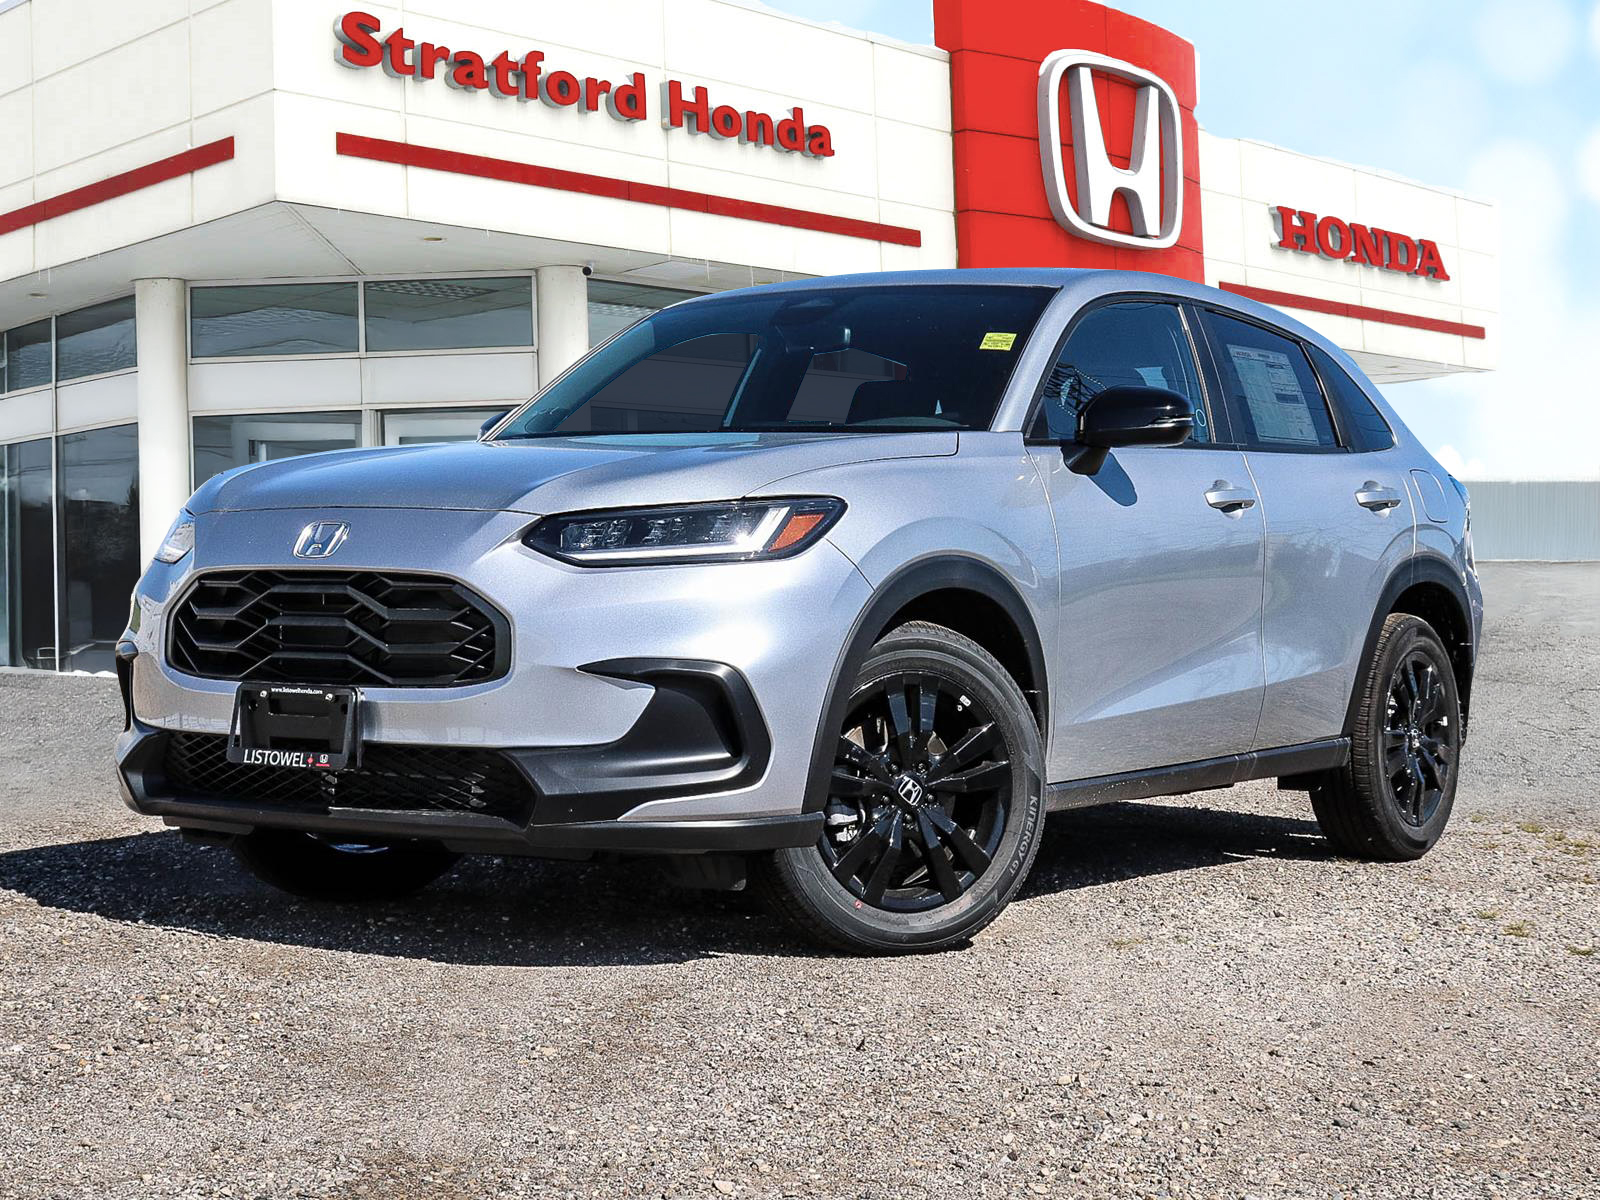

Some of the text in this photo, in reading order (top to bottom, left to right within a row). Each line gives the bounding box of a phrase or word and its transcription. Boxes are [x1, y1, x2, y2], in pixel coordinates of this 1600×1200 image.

[335, 11, 835, 158] Stratford Honda
[1268, 205, 1450, 282] HONDA
[243, 749, 307, 768] LISTOWEL
